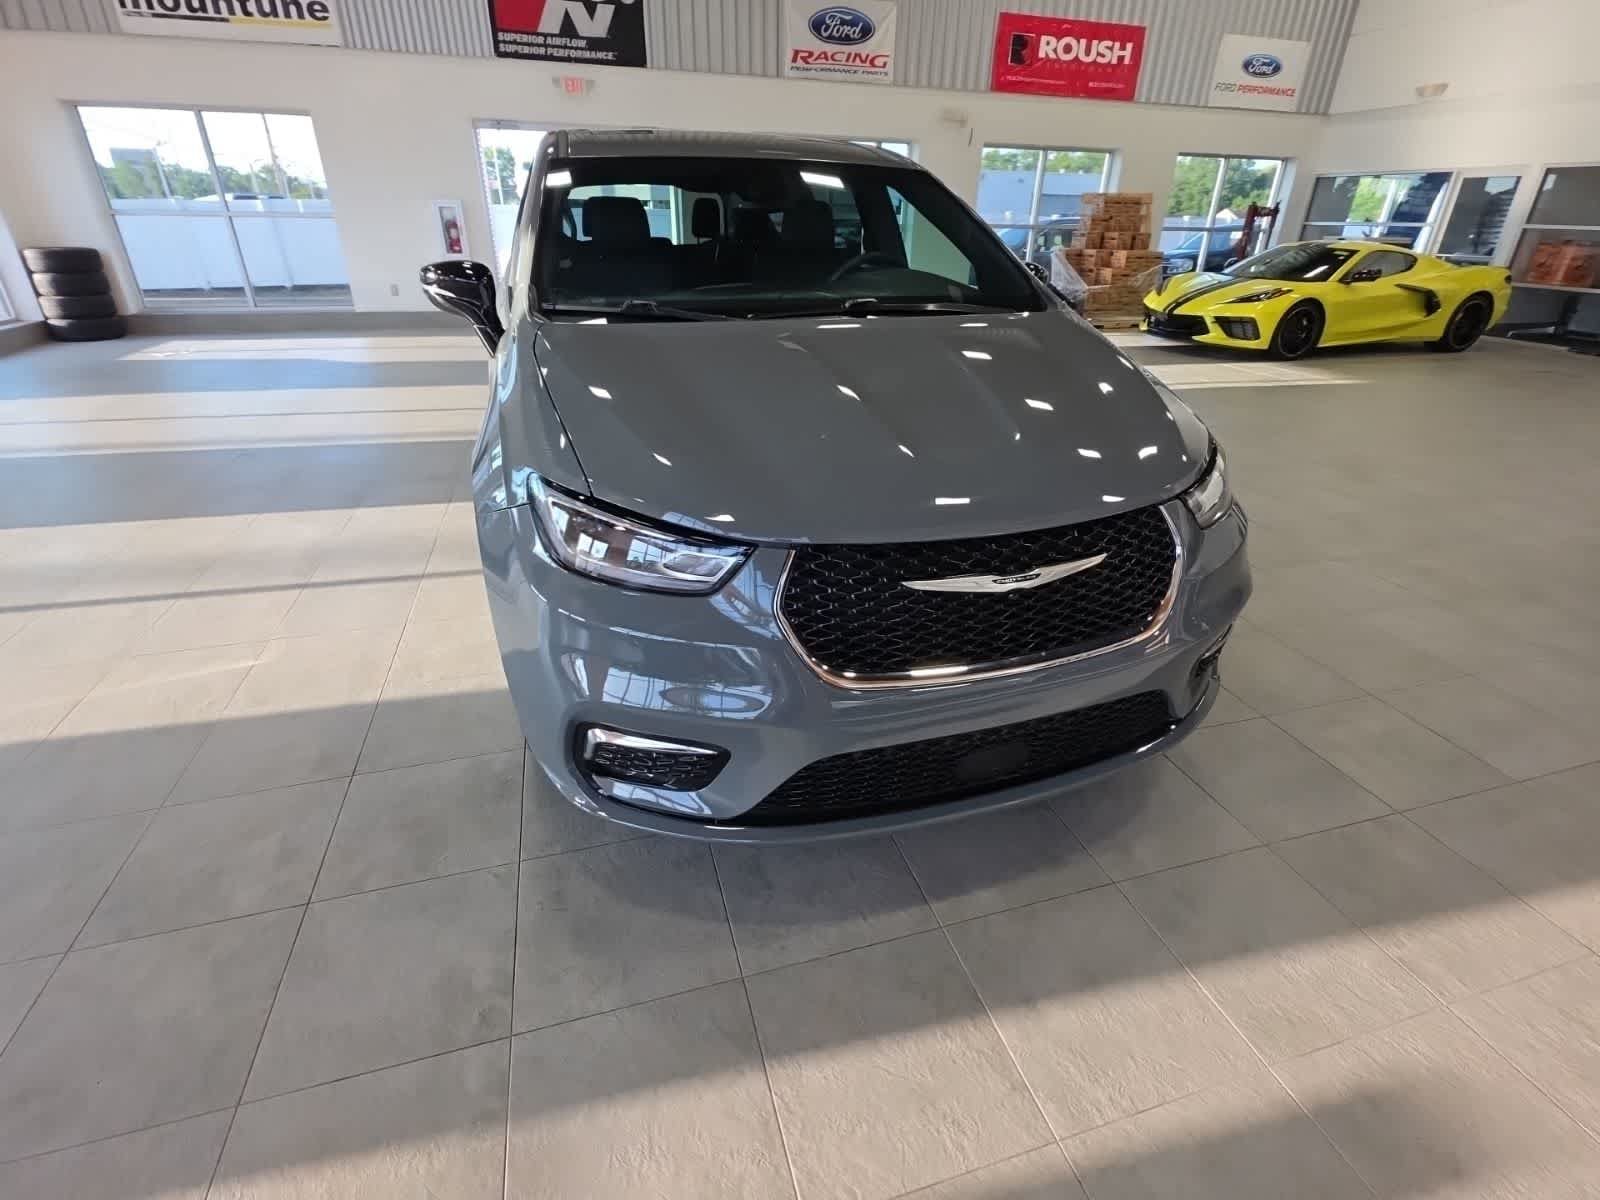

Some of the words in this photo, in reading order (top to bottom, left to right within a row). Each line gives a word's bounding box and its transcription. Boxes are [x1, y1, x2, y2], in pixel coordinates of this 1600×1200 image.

[821, 12, 863, 39] Ford
[497, 31, 545, 45] SUPERIOR
[498, 43, 546, 55] SUPERIOR
[791, 48, 890, 69] RACING
[1038, 34, 1134, 65] ROUSH
